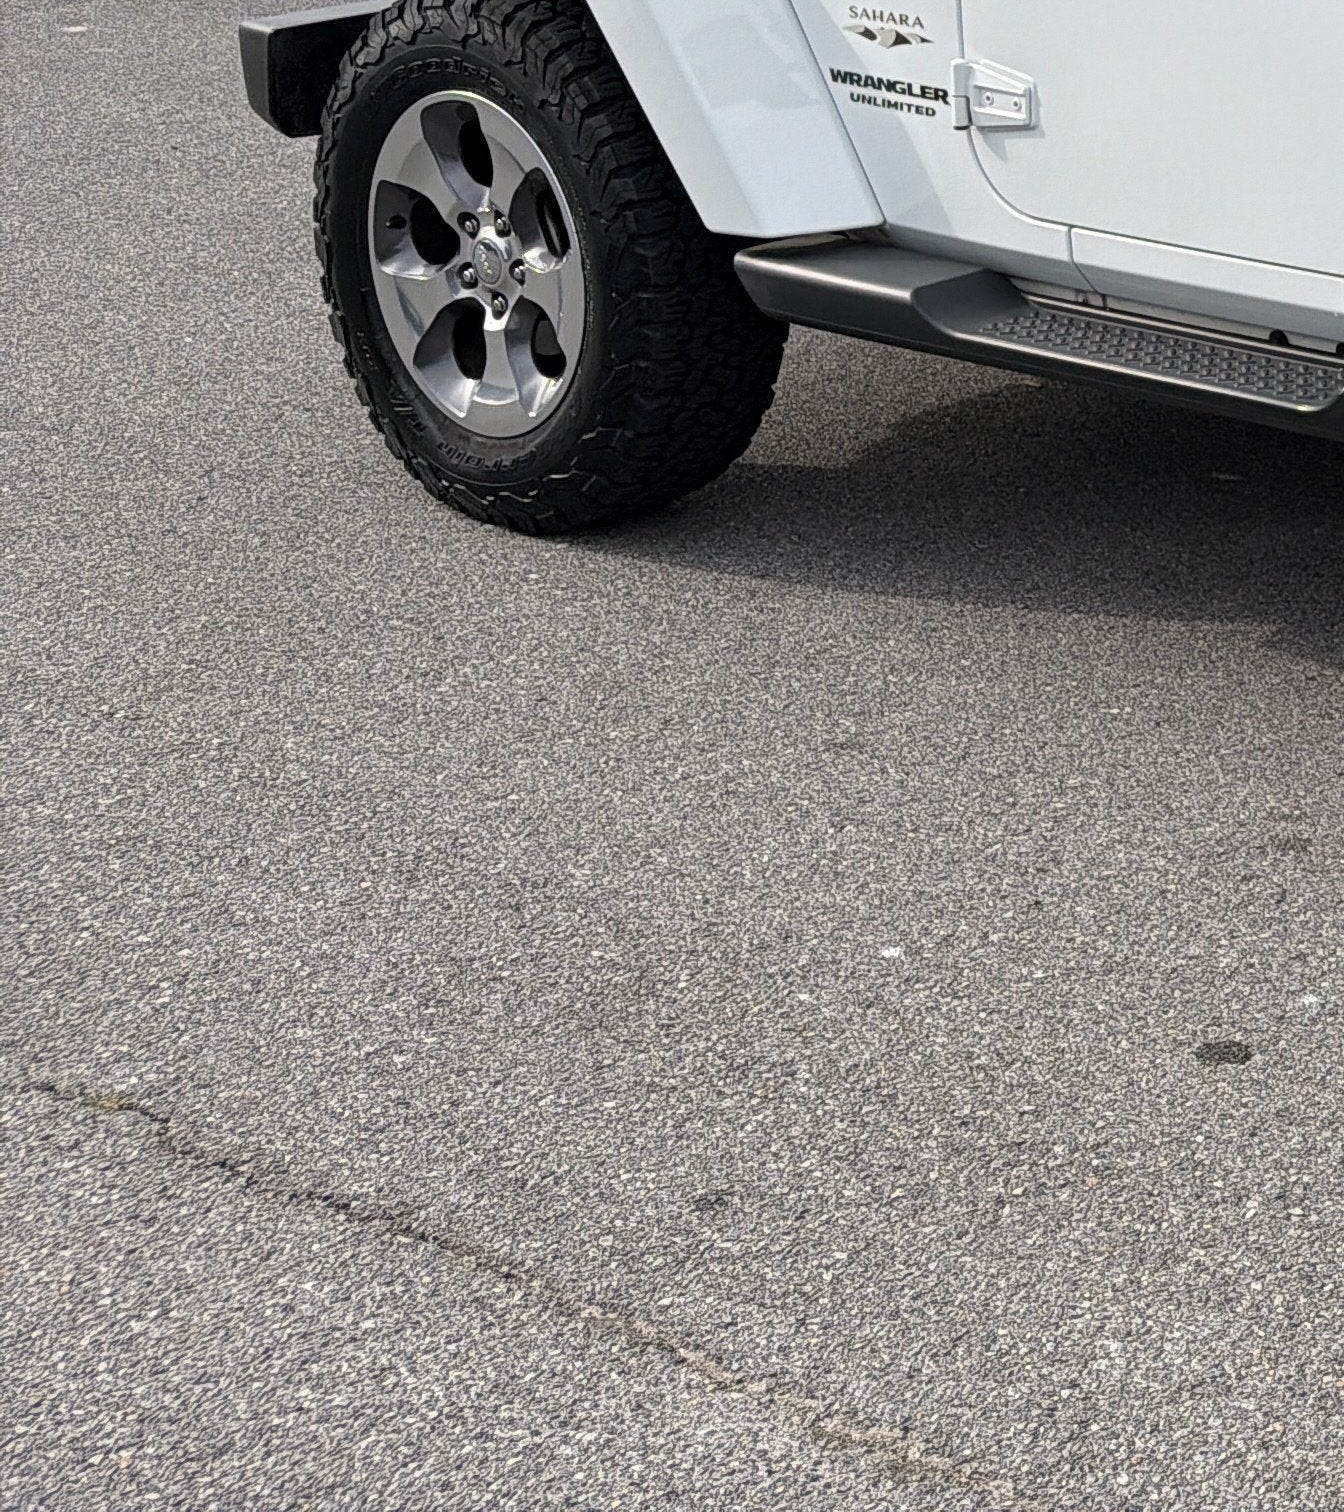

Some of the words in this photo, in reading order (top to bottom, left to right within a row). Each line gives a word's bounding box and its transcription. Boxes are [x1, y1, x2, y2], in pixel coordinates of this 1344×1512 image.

[849, 5, 925, 29] SAHARA
[829, 67, 951, 106] WRANGLER
[849, 92, 936, 117] UNLIMITED
